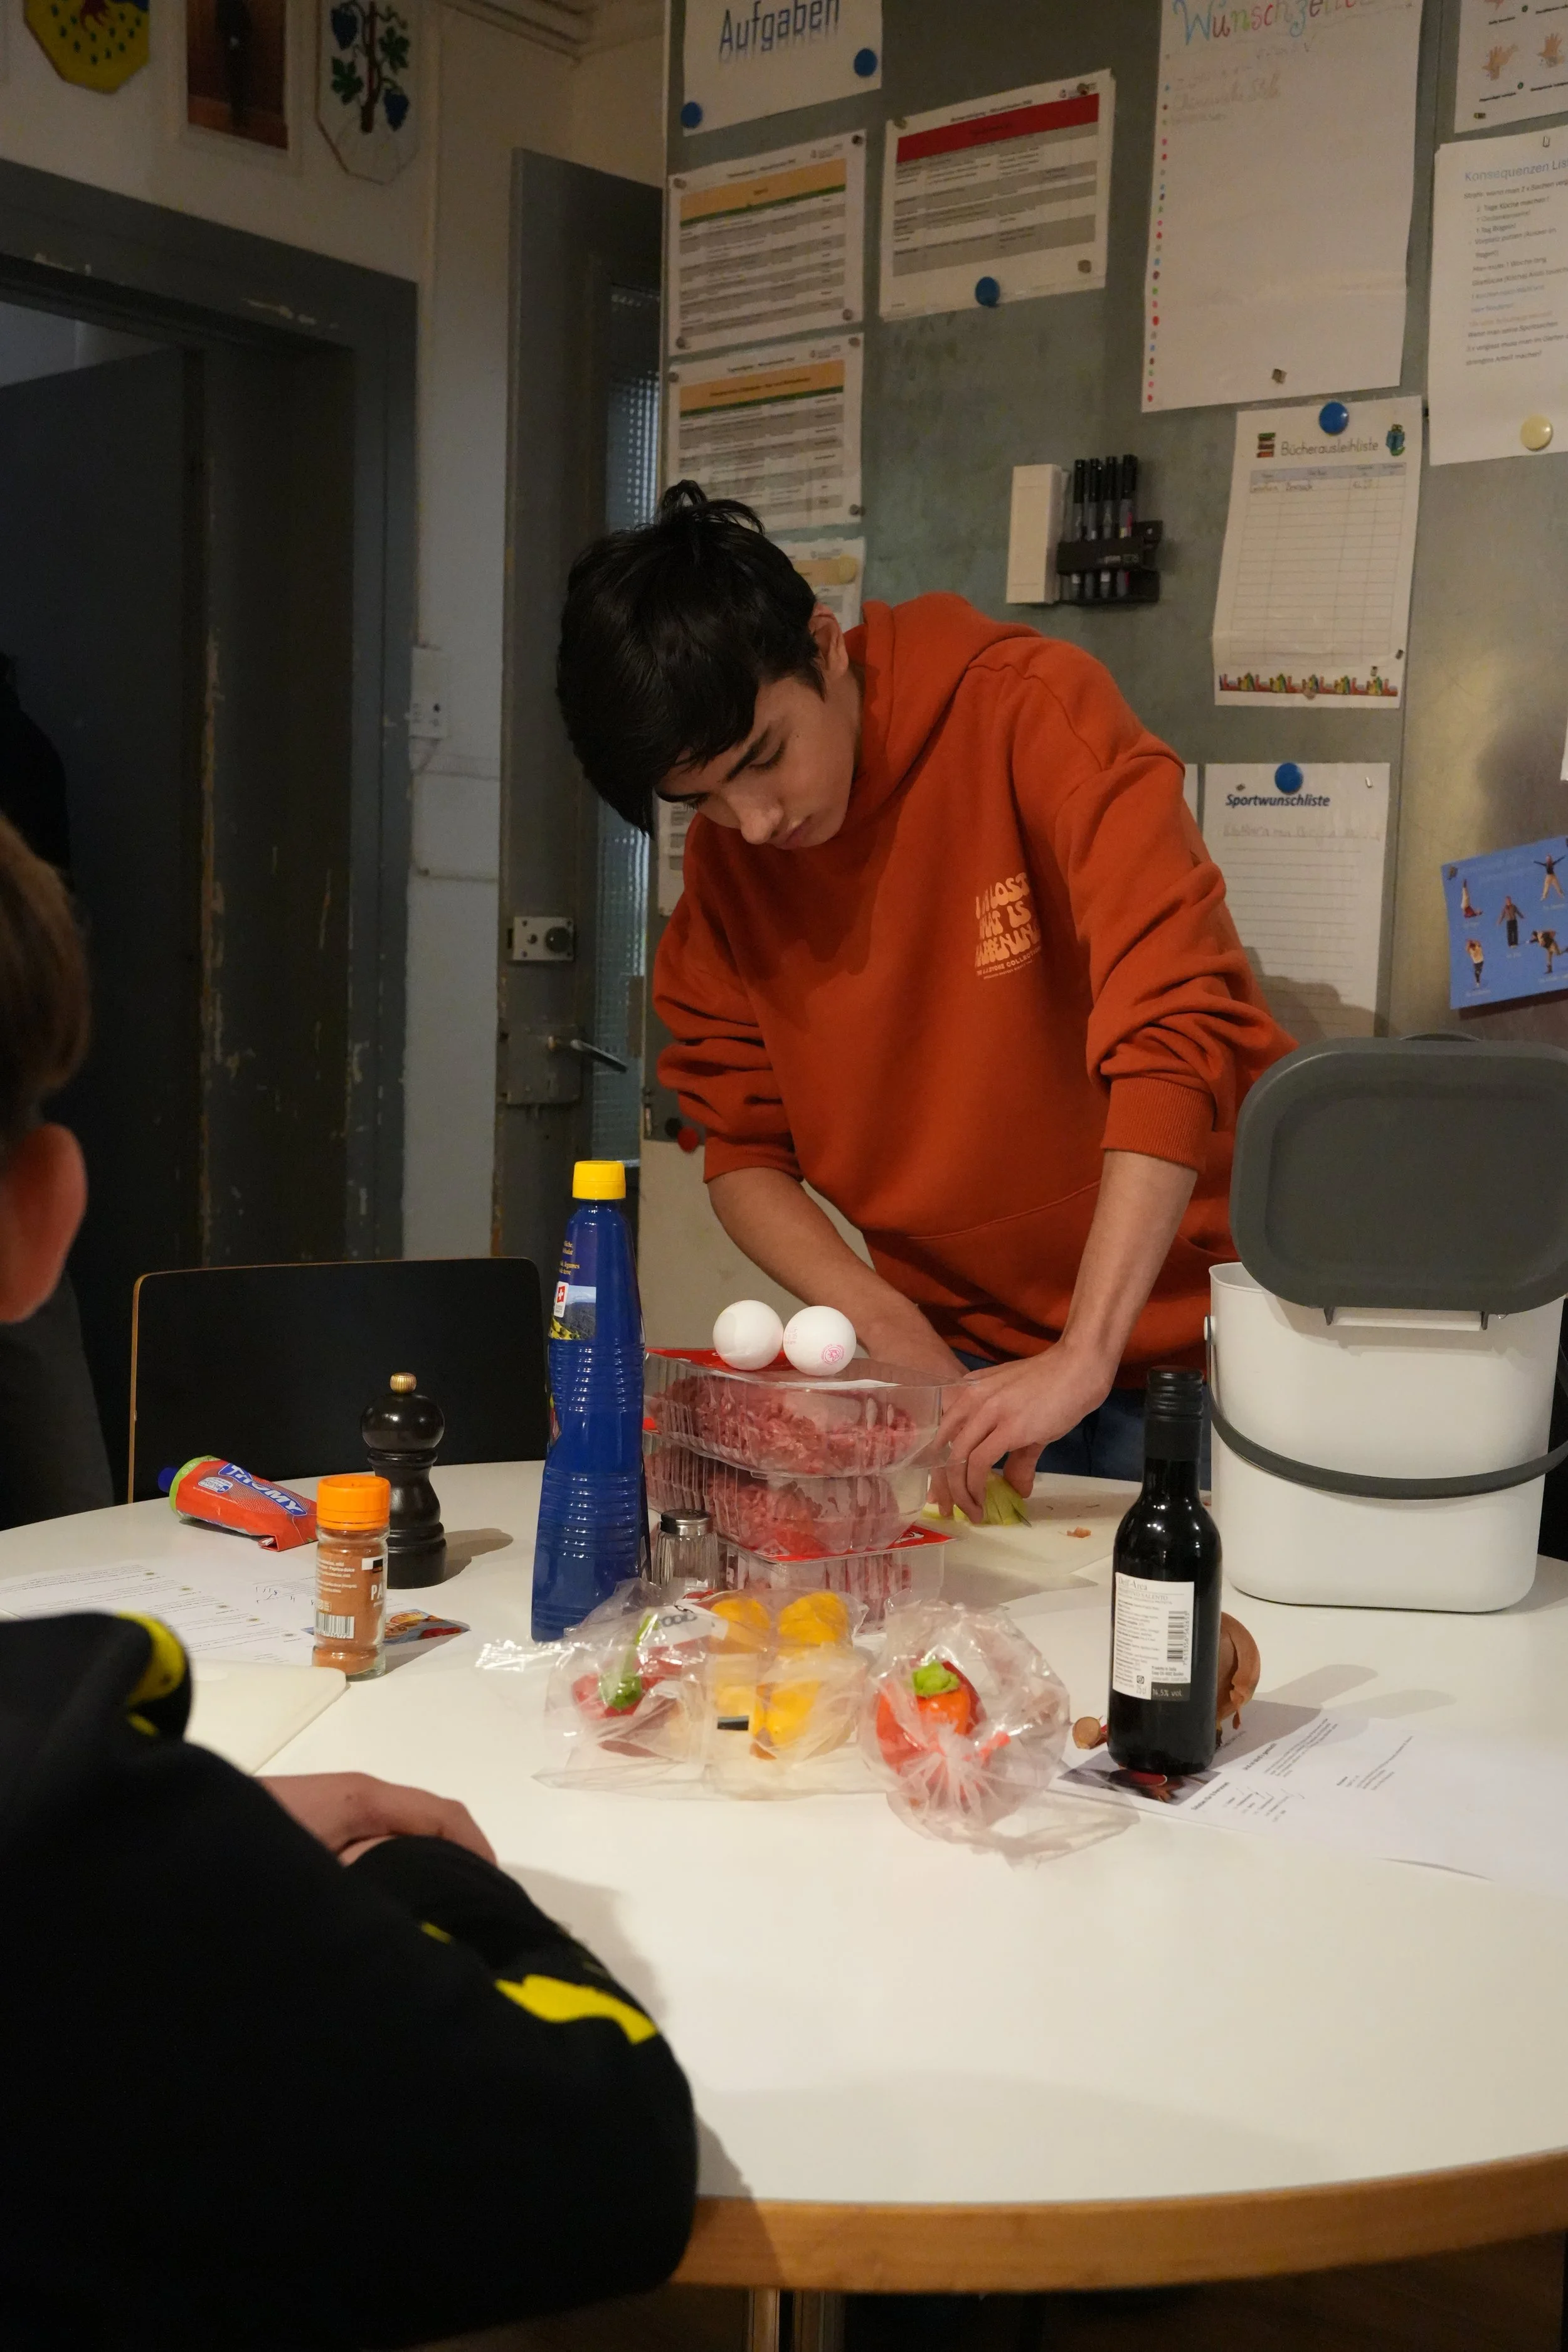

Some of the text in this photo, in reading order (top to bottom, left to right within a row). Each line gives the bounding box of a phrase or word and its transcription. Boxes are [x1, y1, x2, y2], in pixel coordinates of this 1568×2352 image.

[719, 0, 839, 52] Aufgaben
[1465, 162, 1549, 181] Konsequenzen
[1281, 436, 1379, 456] Bücherausleihliste
[1226, 793, 1330, 808] Sportwunschliste
